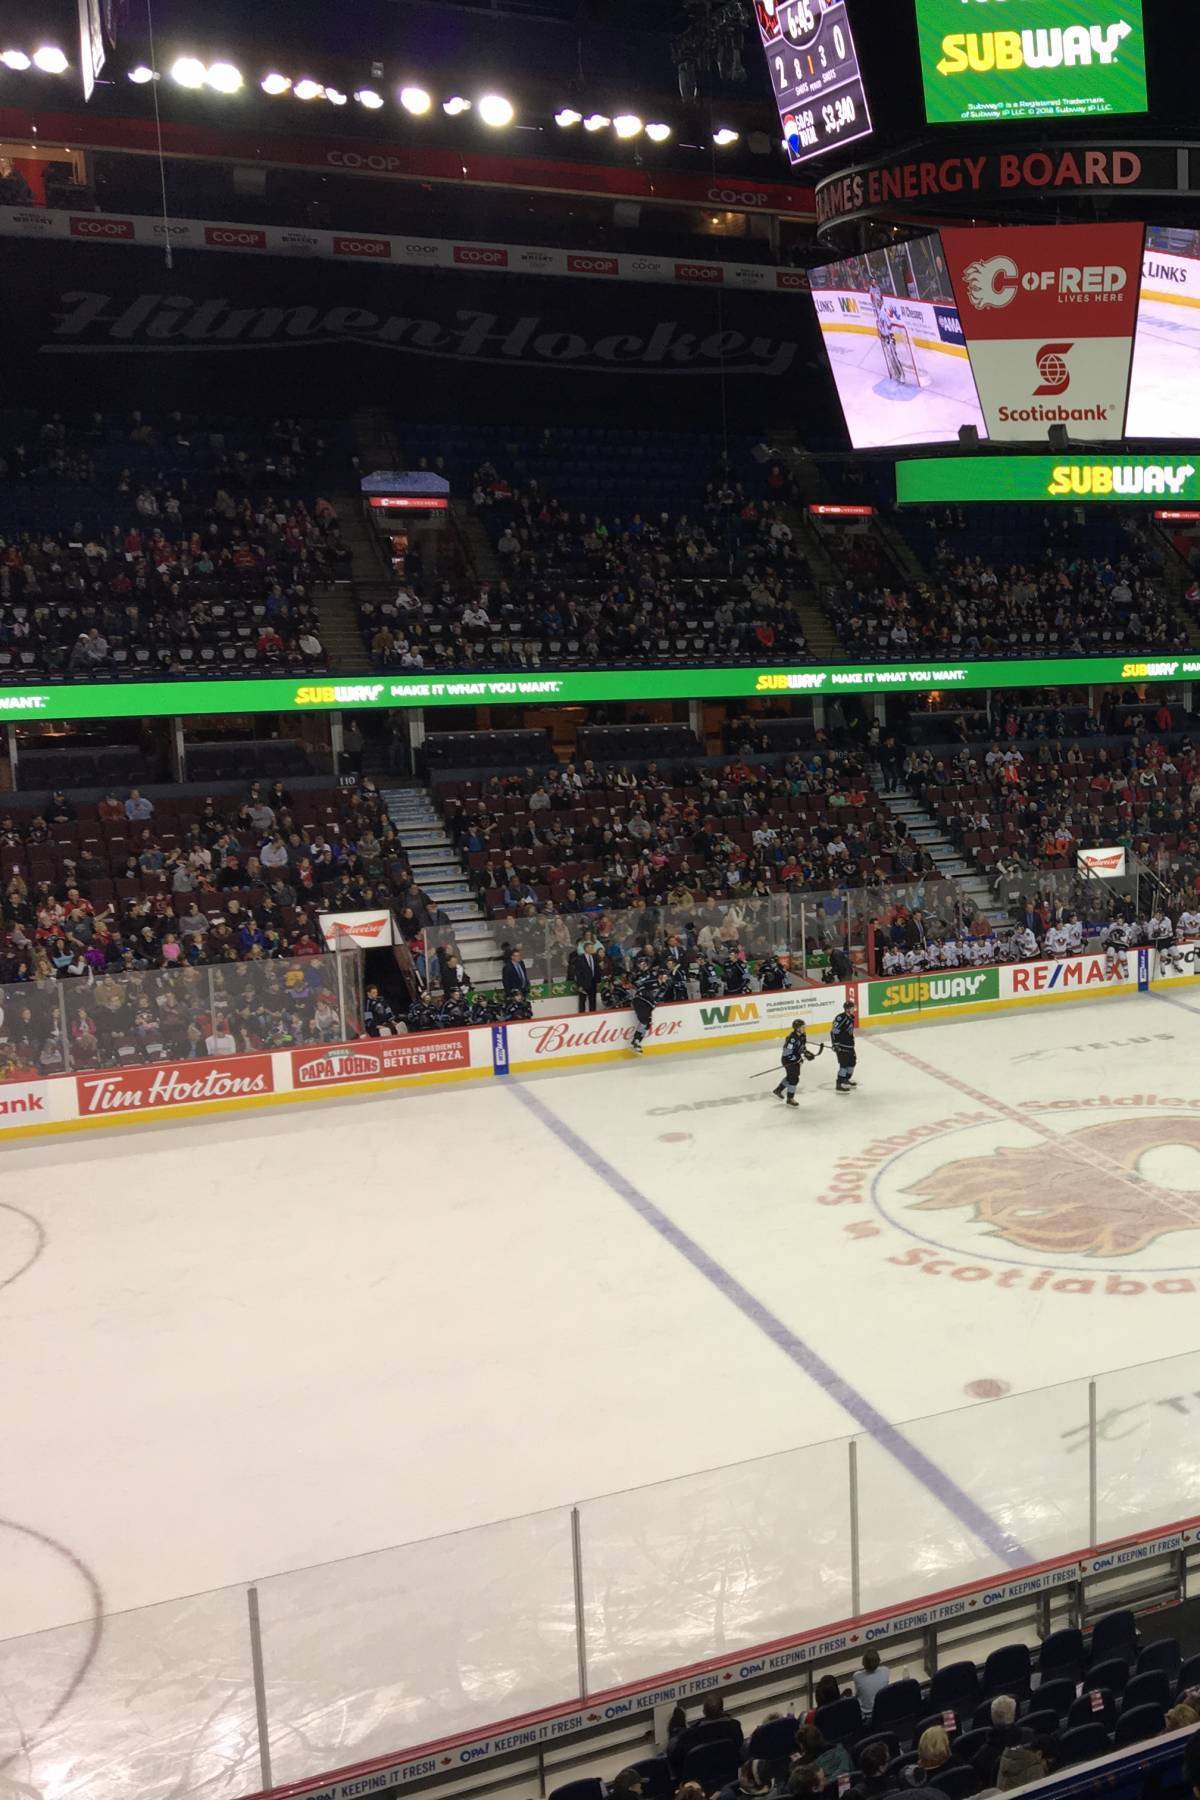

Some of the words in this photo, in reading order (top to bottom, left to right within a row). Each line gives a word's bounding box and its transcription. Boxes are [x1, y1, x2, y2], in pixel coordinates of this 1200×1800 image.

[787, 1, 815, 39] 6:45
[833, 25, 846, 60] 0
[936, 19, 1132, 76] SUBWAY
[775, 56, 788, 89] 2
[793, 58, 803, 80] 8
[818, 45, 827, 67] 3
[821, 96, 856, 133] $3,340
[867, 157, 987, 202] ENERGY
[1000, 151, 1142, 188] BOARD
[1022, 271, 1055, 291] OF
[1059, 266, 1127, 293] RED
[1058, 293, 1089, 303] LIVES
[1095, 292, 1125, 303] HERE
[50, 291, 451, 346] Hitmen
[451, 309, 799, 375] Hockey
[998, 403, 1108, 422] Scotiabank
[1048, 464, 1195, 495] SUBWAY
[756, 672, 827, 690] SUBWAY
[832, 673, 863, 684] MAKE
[864, 673, 875, 683] IT
[875, 672, 908, 683] WHAT
[909, 671, 931, 682] YOU
[1121, 662, 1179, 677] SUBWAY
[295, 685, 384, 704] SUBWAY
[391, 684, 430, 697] MAKE
[432, 684, 444, 695] IT
[446, 683, 487, 695] WHAT
[488, 682, 516, 694] YOU
[882, 974, 986, 1006] SUBWAY
[700, 1003, 760, 1026] WM
[528, 1019, 682, 1053] Budweser
[1064, 1032, 1175, 1052] TELUS
[383, 1048, 414, 1057] BETTER
[384, 1054, 426, 1068] BETTER
[428, 1049, 464, 1062] PIZZA.
[301, 1060, 335, 1081] PAPA
[83, 1078, 142, 1110] Tim
[150, 1070, 266, 1103] Hortons
[817, 1110, 996, 1206] Scotiabank
[1009, 1578, 1041, 1597] KEEPING
[1042, 1576, 1051, 1587] IT
[893, 1612, 928, 1631] KEEPING
[928, 1609, 937, 1621] IT
[939, 1602, 965, 1618] FRESH
[769, 1647, 806, 1669] KEEPING
[808, 1644, 817, 1658] IT
[818, 1637, 846, 1654] FRESH
[636, 1688, 675, 1708] KEEPING
[678, 1684, 687, 1696] IT
[690, 1675, 719, 1694] FRESH
[494, 1729, 536, 1752] KEEPING
[539, 1725, 548, 1739] IT
[551, 1717, 582, 1735] FRESH
